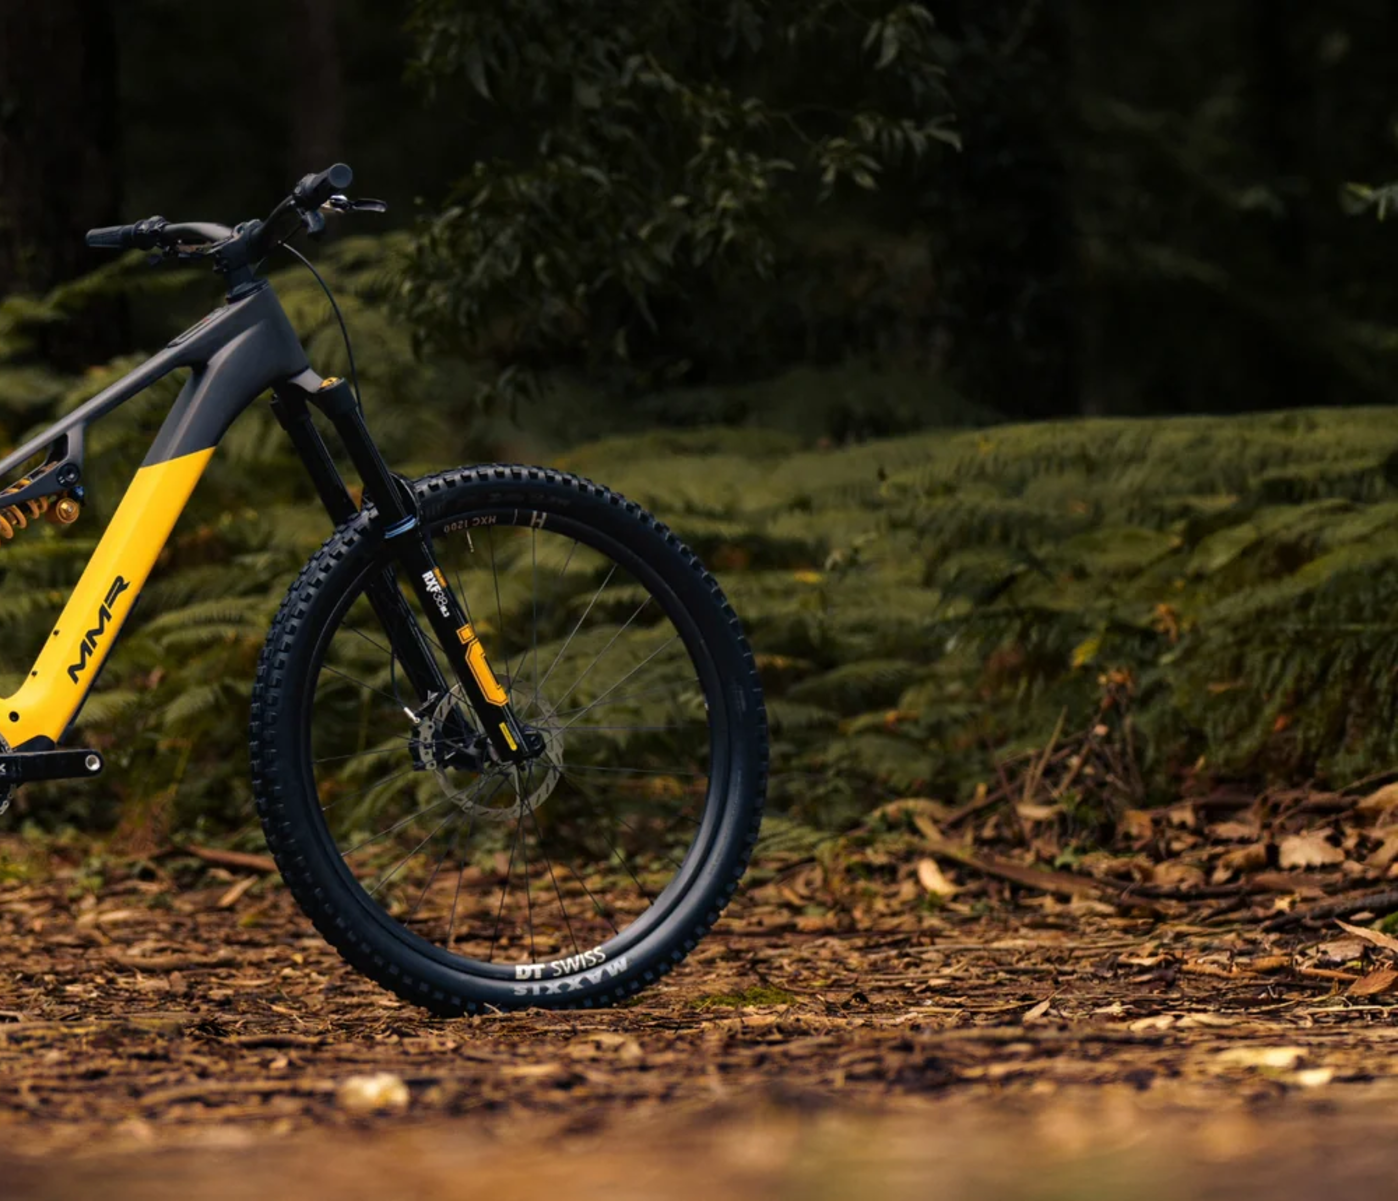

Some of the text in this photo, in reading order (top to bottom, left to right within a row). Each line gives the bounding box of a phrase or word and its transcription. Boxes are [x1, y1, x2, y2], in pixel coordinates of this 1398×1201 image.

[443, 519, 468, 533] 1200
[67, 575, 130, 685] MMR
[513, 956, 629, 996] MAXXIS
[515, 946, 606, 980] DT SWISS
